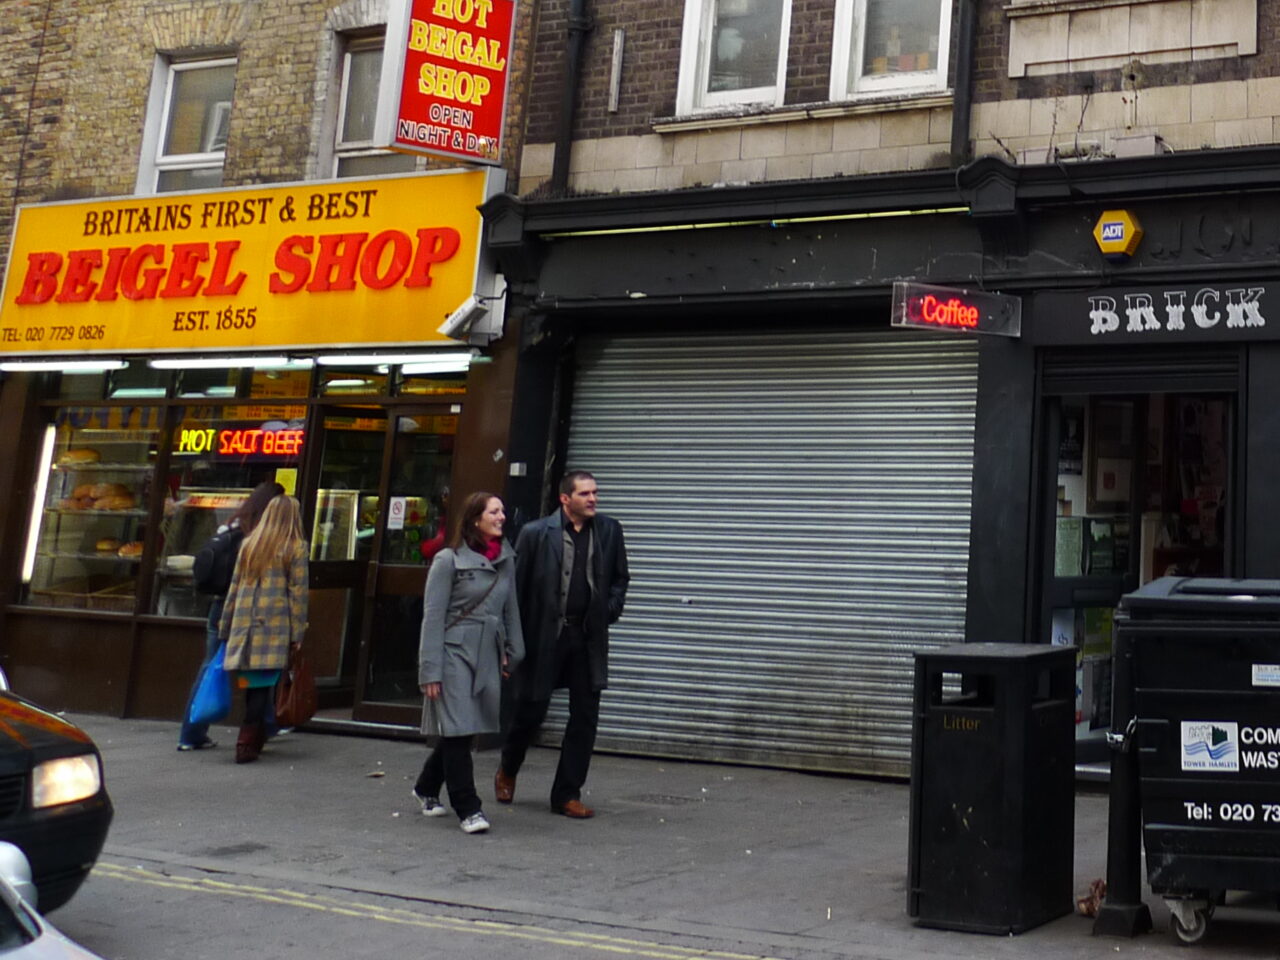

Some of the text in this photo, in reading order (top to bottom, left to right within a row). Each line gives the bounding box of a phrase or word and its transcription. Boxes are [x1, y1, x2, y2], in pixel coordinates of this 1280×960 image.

[408, 18, 506, 72] BEIGAL
[418, 62, 491, 107] SHOP
[429, 103, 474, 129] OPEN
[398, 119, 499, 159] NIGHT & DY
[83, 190, 378, 237] BRITAINS FIRST & BEST
[1102, 223, 1124, 240] ADT
[15, 226, 462, 306] BEIGEL SHOP
[172, 305, 257, 332] EST. 1855
[922, 294, 979, 328] Coffee
[1087, 286, 1267, 335] BRICK
[25, 327, 46, 342] 020
[49, 326, 75, 341] 7729
[78, 325, 106, 340] 0826
[179, 428, 304, 455] HOT SALT BEEF
[943, 713, 981, 730] Litter
[1184, 760, 1206, 768] TOWER
[1183, 802, 1212, 820] Tel:
[1219, 803, 1255, 821] 020
